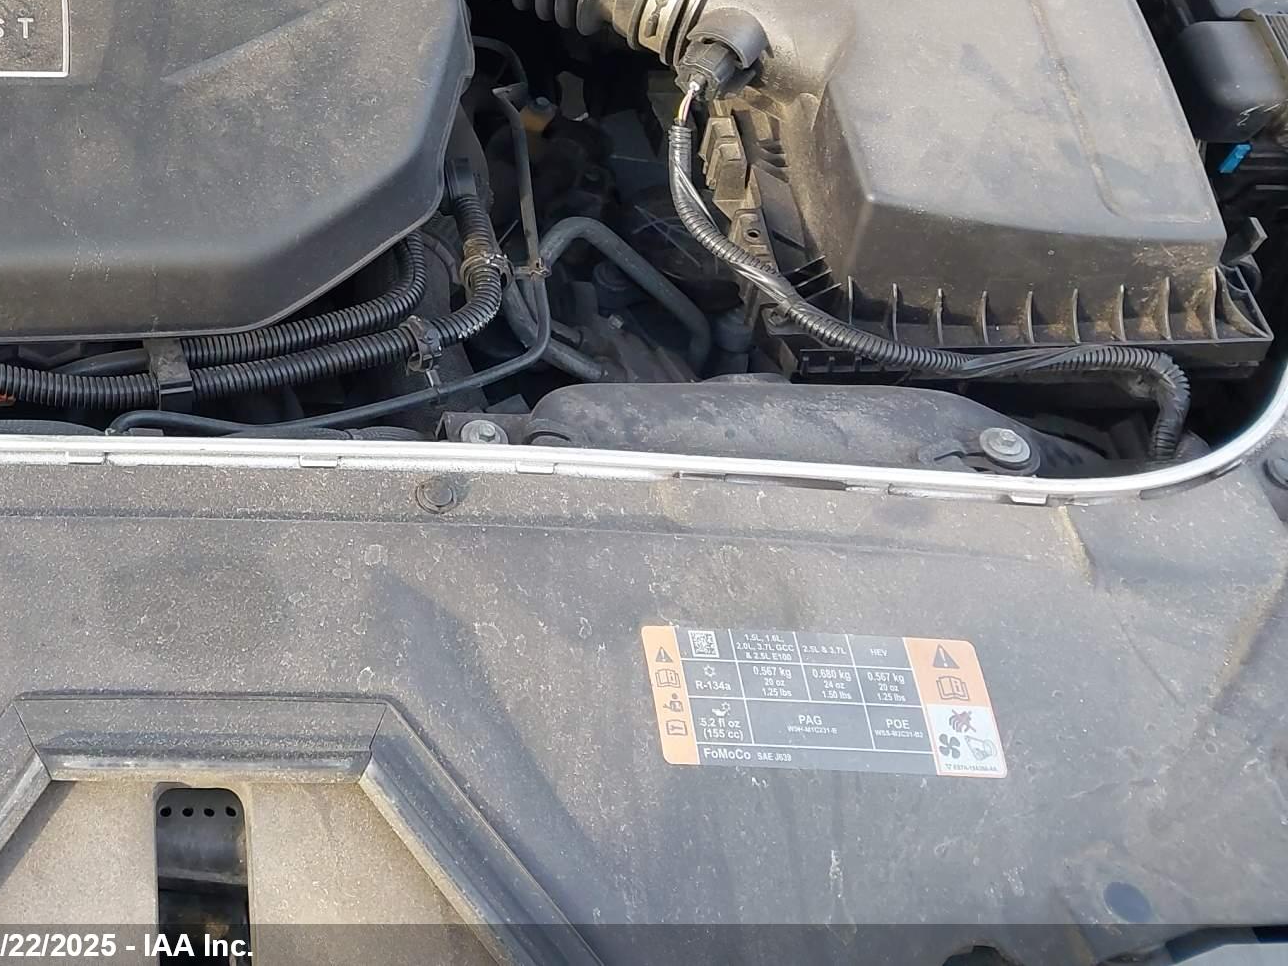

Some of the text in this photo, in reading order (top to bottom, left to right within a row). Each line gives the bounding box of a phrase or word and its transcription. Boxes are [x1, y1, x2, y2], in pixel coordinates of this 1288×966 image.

[776, 644, 795, 652] GCC
[753, 665, 792, 679] 0.567 kg
[839, 669, 851, 682] kg
[867, 671, 905, 684] 0.567 kg
[695, 680, 732, 691] R-134a
[764, 678, 774, 686] 20
[762, 687, 793, 697] 1.25 lbs
[839, 691, 853, 700] lbs
[877, 693, 907, 702] 1.25 lbs
[699, 718, 716, 728] 5.2
[728, 719, 741, 728] oz
[798, 714, 823, 726] PAG
[885, 718, 911, 730] POE
[704, 728, 744, 741] (155 cc)
[704, 748, 751, 760] FoMoCo
[757, 752, 774, 761] SAE
